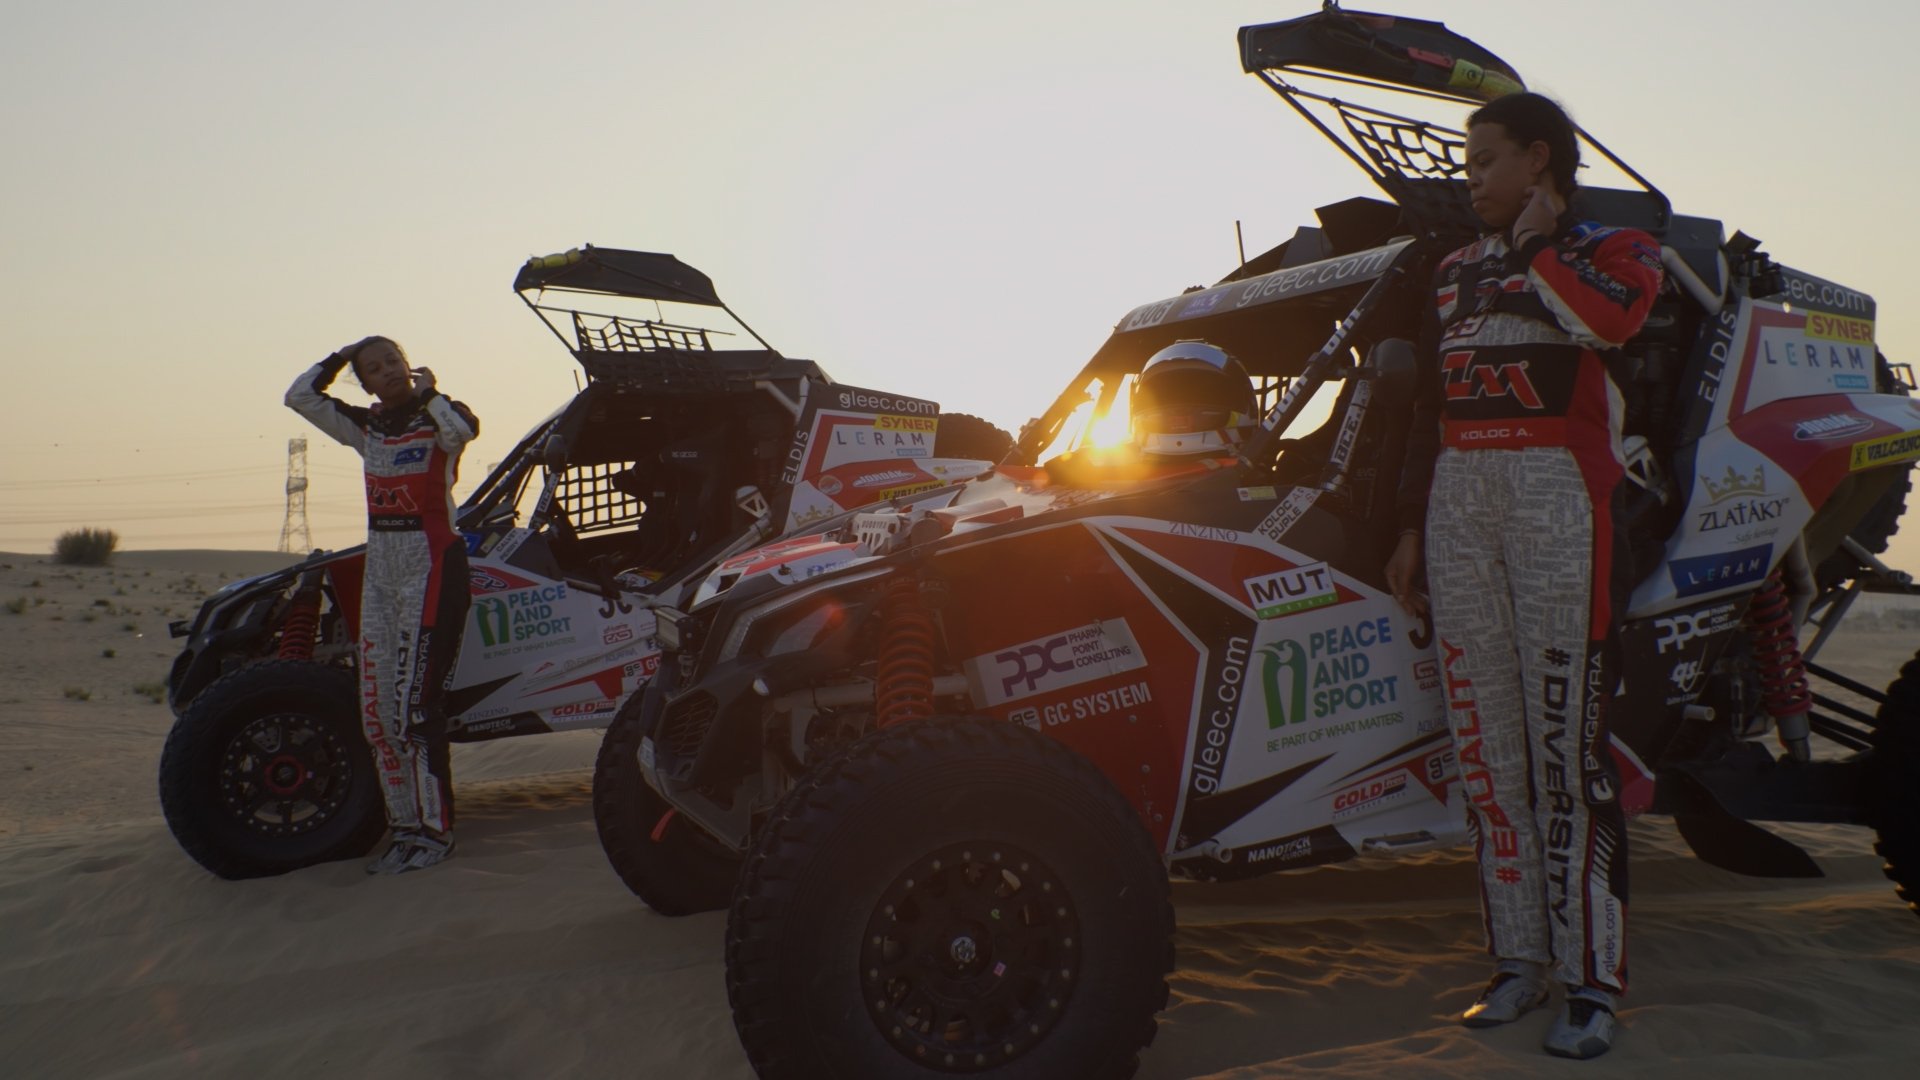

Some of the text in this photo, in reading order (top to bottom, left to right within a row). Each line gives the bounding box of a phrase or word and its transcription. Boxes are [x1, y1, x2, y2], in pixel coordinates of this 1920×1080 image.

[1236, 248, 1387, 308] gleec.com
[1811, 314, 1873, 342] SYNER
[1697, 310, 1737, 403] ELDIS
[1764, 339, 1864, 369] LERAM
[838, 389, 937, 416] gleec.com
[836, 430, 925, 446] LERAM
[880, 416, 935, 431] SYNER
[1460, 427, 1534, 441] KOLOC A.
[780, 431, 808, 485] ELDIS
[1169, 521, 1239, 543] ZINZINO
[1257, 500, 1293, 536] KOLOC
[1687, 556, 1762, 585] LERAM
[507, 584, 567, 609] PEACE
[1250, 568, 1325, 604] MUT
[513, 604, 553, 625] AND
[514, 617, 572, 641] SPORT
[1068, 626, 1106, 644] PHARMA
[1309, 616, 1393, 660] PEACE
[1653, 608, 1713, 655] PPC
[483, 635, 577, 661] BE PART OF WHAT MATTERS
[1072, 640, 1101, 656] POINT
[1075, 645, 1132, 669] CONSULTING
[410, 631, 433, 705] BUGGYRA
[995, 635, 1075, 698] PPC
[1313, 652, 1370, 689] AND
[552, 702, 597, 716] GOLD
[1043, 703, 1072, 727] GC
[1072, 681, 1153, 721] SYSTEM
[1313, 674, 1399, 718] SPORT
[467, 705, 510, 721] ZINZINO
[1193, 636, 1249, 796] gleec.com
[1584, 652, 1604, 771] BUGGYRA
[1266, 711, 1404, 753] BE PART OF WHAT MATTERS
[1333, 783, 1382, 811] GOLD
[1543, 647, 1575, 928] #DIVERSITY
[1604, 896, 1617, 974] gleec.com
